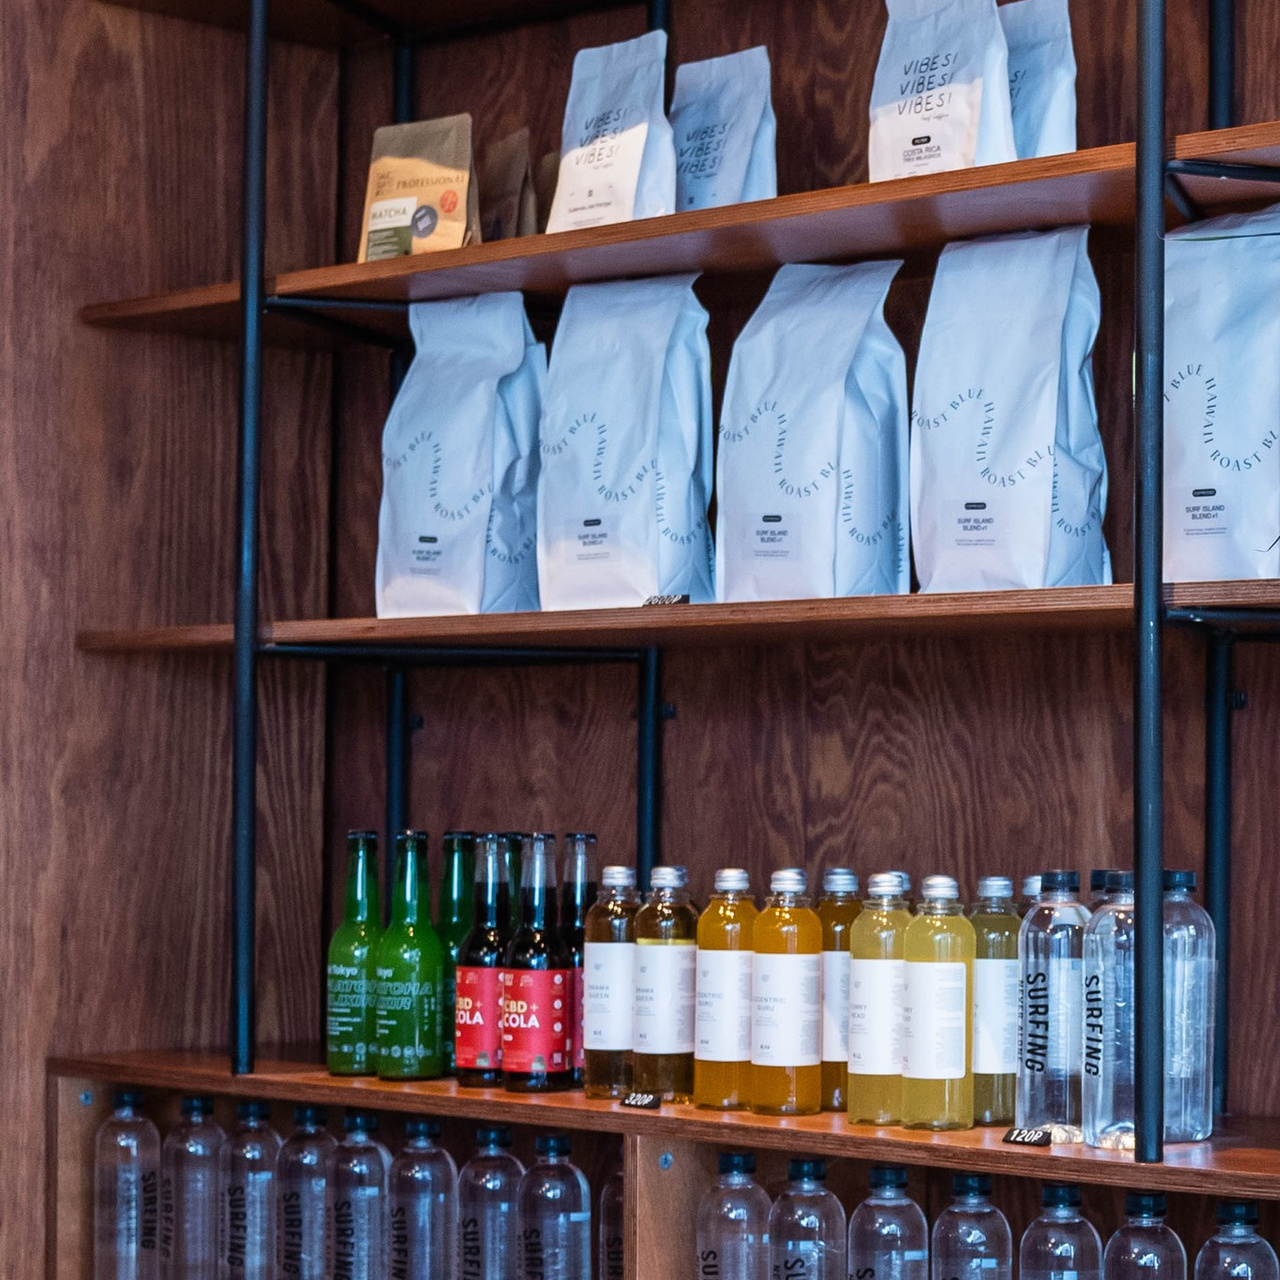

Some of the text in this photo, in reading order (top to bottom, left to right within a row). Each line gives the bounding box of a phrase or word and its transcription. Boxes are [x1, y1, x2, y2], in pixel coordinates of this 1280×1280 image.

[902, 52, 959, 76] VIBES!
[899, 72, 955, 96] VIBES!
[897, 92, 953, 116] VIBES!
[584, 108, 629, 131] VIBES!
[575, 145, 621, 166] VIBES!
[679, 138, 728, 159] VIBES!
[950, 388, 984, 411] BLUE
[1171, 364, 1203, 389] BLUE
[1203, 377, 1217, 444] HAWAII
[1210, 449, 1262, 472] ROAST
[976, 401, 995, 462] HAWAII
[1026, 445, 1056, 469] BLU
[980, 467, 1026, 488] ROAST
[597, 484, 635, 502] ROAST
[779, 478, 819, 498] ROAST
[849, 527, 883, 546] ROAST
[456, 997, 473, 1010] BD
[504, 1000, 528, 1013] CBD
[503, 1013, 540, 1028] COLA
[1025, 972, 1049, 1072] SURFING
[1084, 974, 1103, 1077] SURFING
[142, 1171, 157, 1249] SURFING
[228, 1186, 247, 1267] SURFING
[283, 1191, 302, 1275] SURFING
